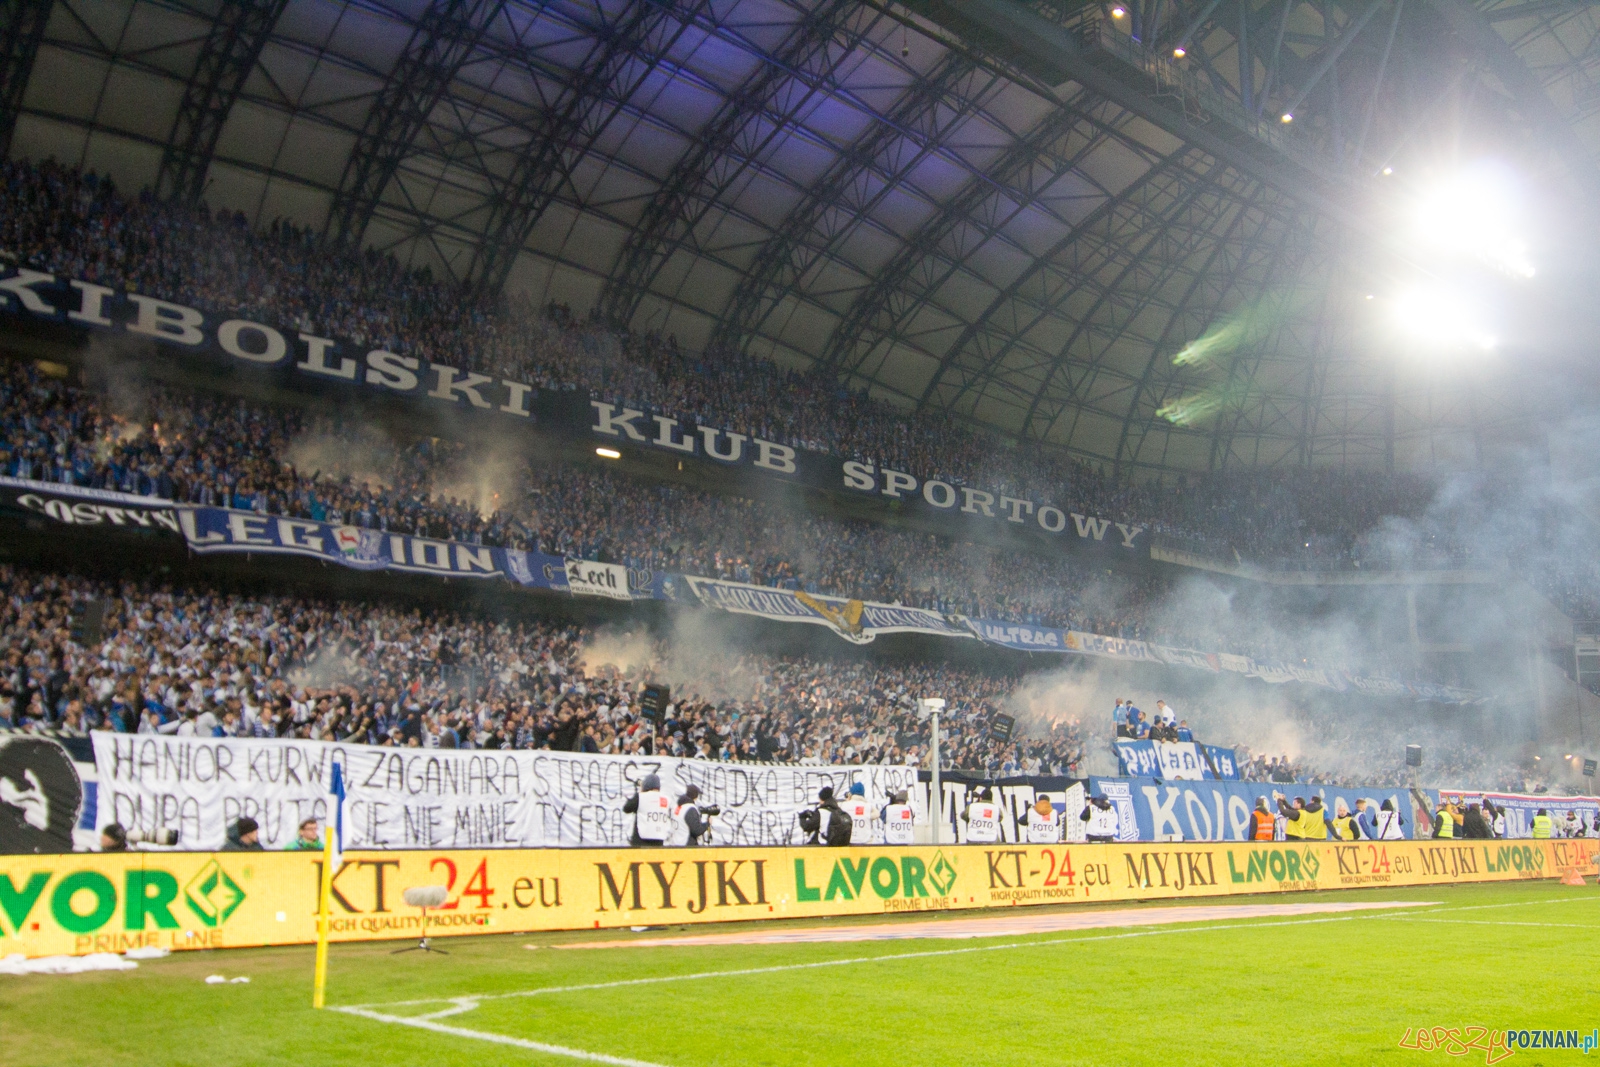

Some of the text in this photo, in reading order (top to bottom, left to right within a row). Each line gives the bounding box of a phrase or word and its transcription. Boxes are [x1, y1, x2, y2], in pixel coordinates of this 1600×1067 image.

[590, 401, 797, 473] KLUB
[842, 460, 1143, 548] SPORTOWY
[986, 625, 1058, 647] ULTRAS
[405, 804, 442, 845] NIE
[536, 801, 566, 843] TY
[854, 819, 865, 828] TO
[971, 820, 993, 829] FOTO
[1033, 823, 1053, 832] FOTO
[984, 848, 1110, 889] KT-24.eu
[1124, 851, 1218, 891] MYJKI
[1227, 849, 1304, 884] LAVOR
[1334, 844, 1413, 875] KT-24.eu
[1418, 846, 1479, 877] MYJKI
[1483, 845, 1535, 873] LAVOR
[312, 856, 562, 915] KT24.eu
[593, 859, 770, 914] MYJKI
[794, 856, 931, 903] LAVOR
[991, 887, 1075, 900] HIGH QUALITY PRODUCT
[1279, 880, 1318, 890] PRIME LINE
[0, 870, 181, 936] VOR
[884, 896, 950, 911] PRIME LINE
[361, 916, 422, 932] QUALITY
[426, 913, 491, 927] PRODUCT
[75, 929, 223, 952] PRIME LINE
